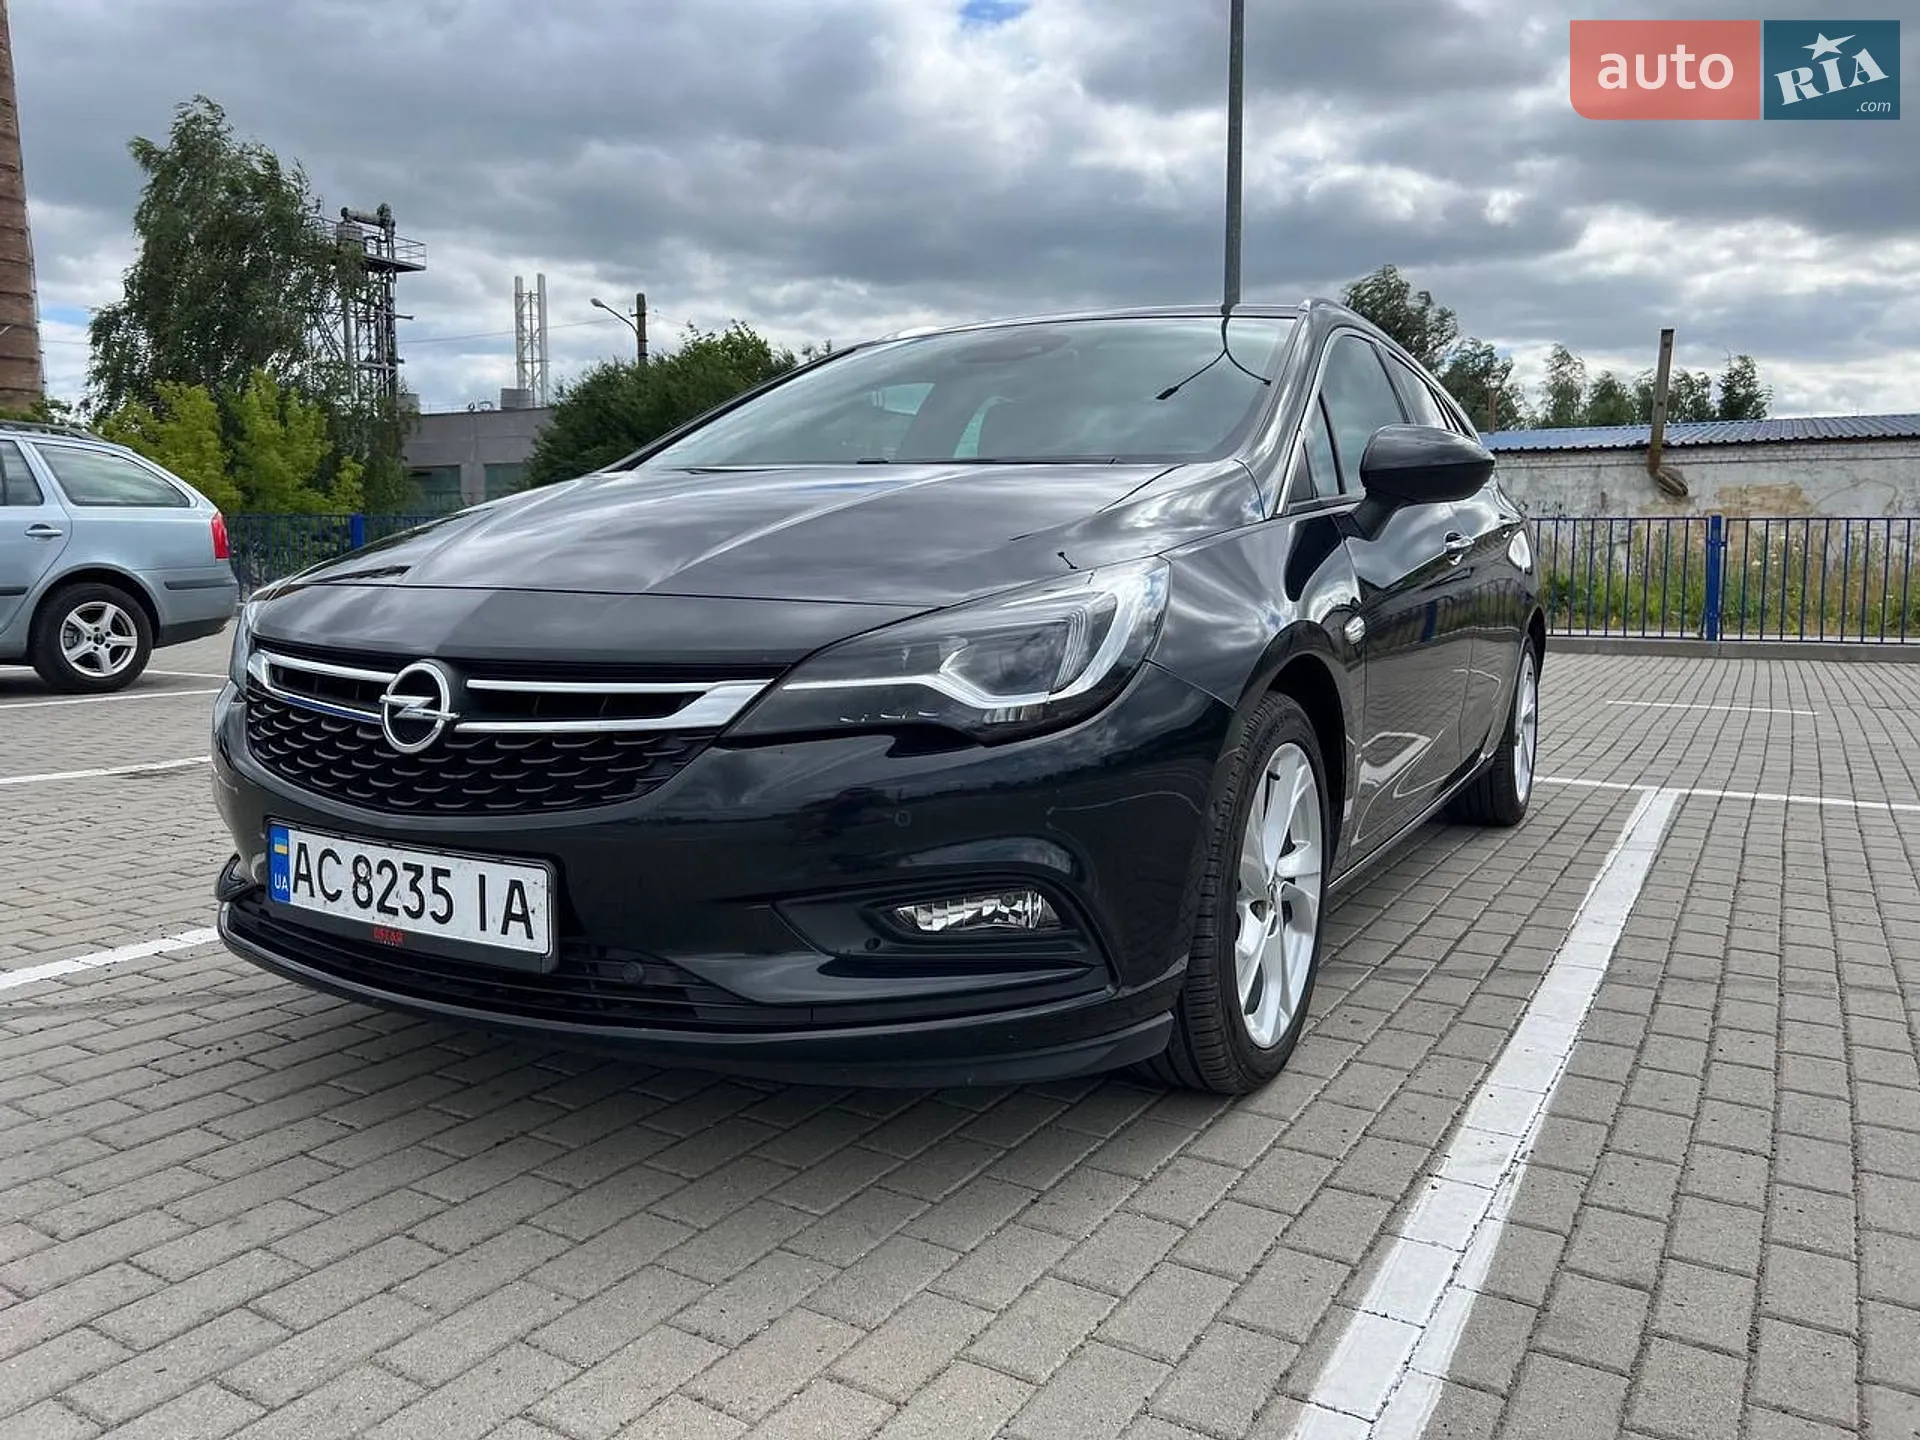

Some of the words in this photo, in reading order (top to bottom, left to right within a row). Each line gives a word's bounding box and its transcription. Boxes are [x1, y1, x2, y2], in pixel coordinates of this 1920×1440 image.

[274, 873, 288, 891] UA
[292, 842, 342, 902] AC
[352, 854, 454, 925] 8235
[478, 873, 534, 940] IA
